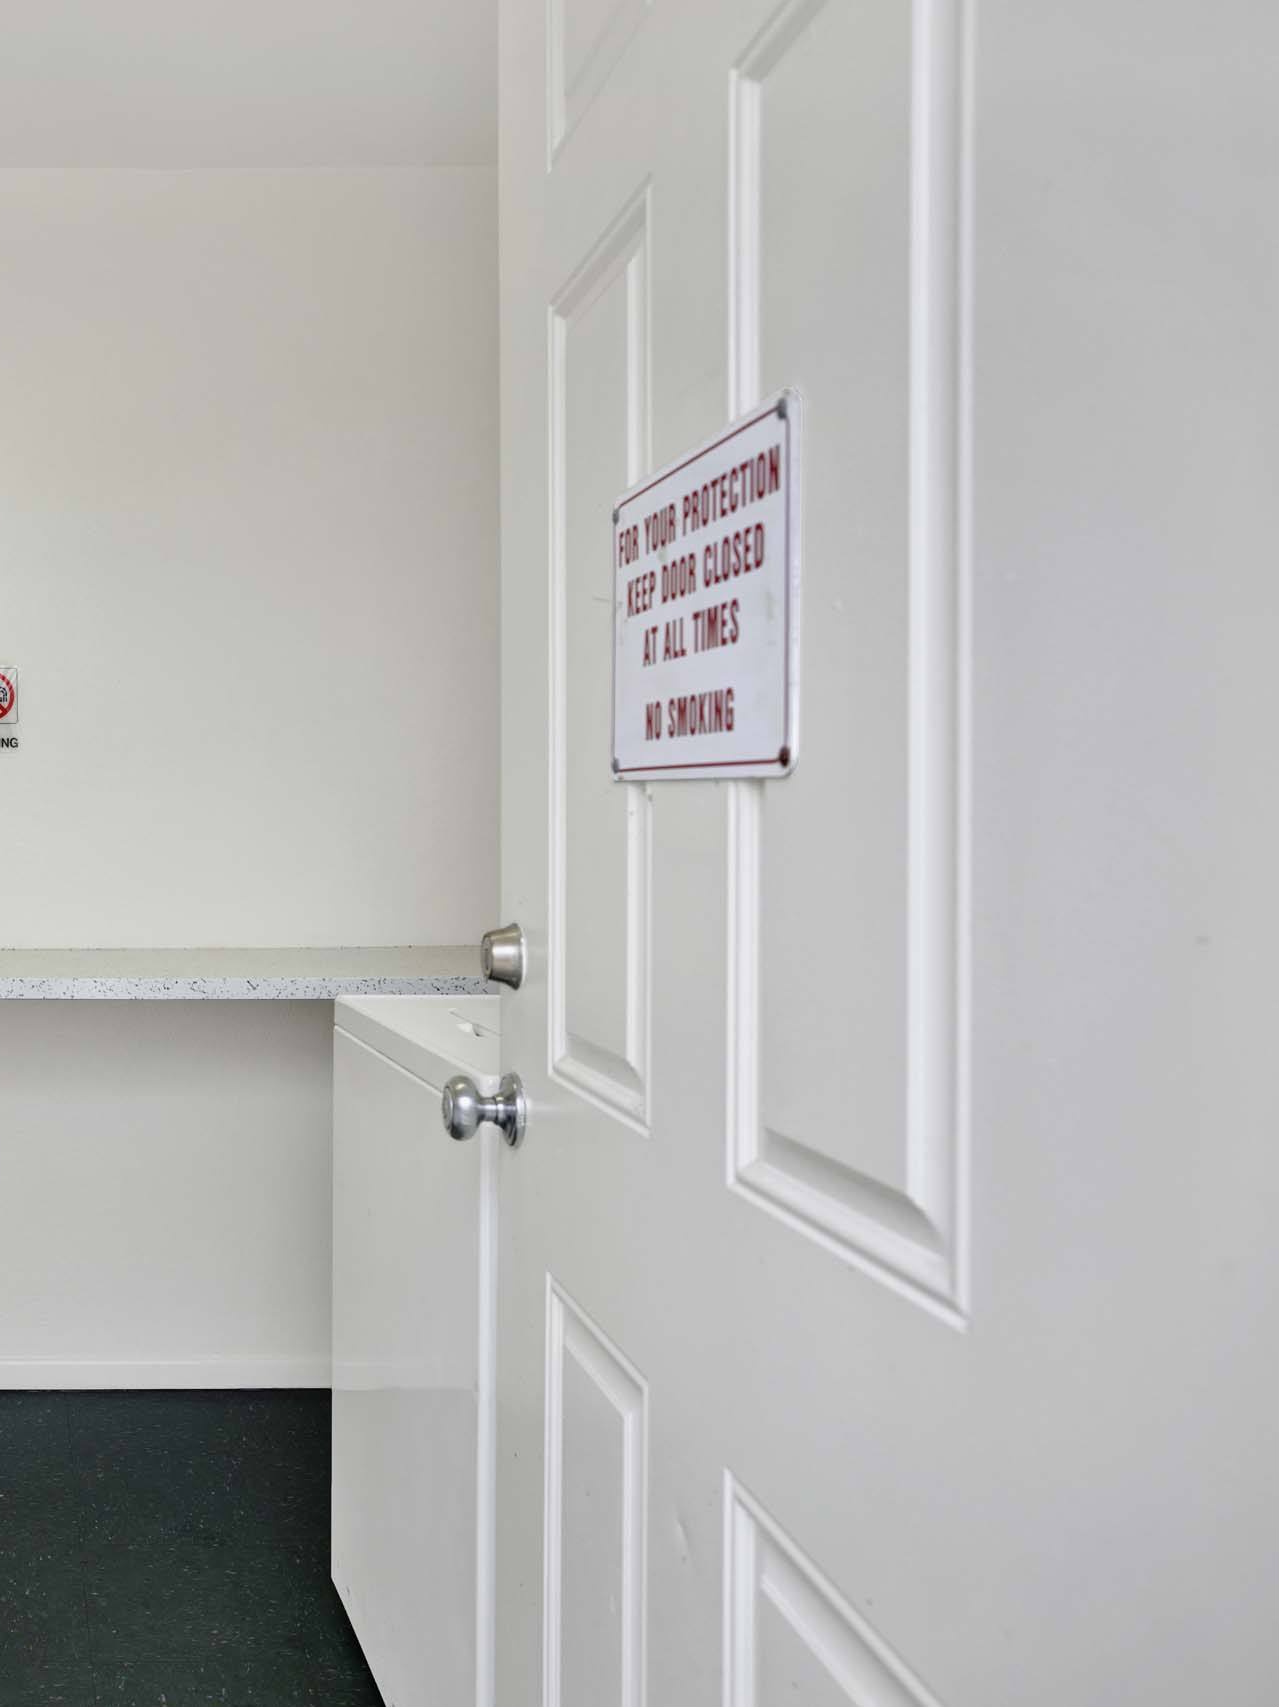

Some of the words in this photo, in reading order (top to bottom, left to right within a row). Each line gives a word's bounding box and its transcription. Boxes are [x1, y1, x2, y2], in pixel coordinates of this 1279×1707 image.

[618, 524, 639, 568] FOR
[644, 503, 676, 555] YOUR
[682, 444, 781, 536] PROTECTION
[627, 570, 657, 617] KEEP
[662, 552, 696, 604] DOOR
[704, 522, 765, 588] CLOSED
[643, 625, 658, 667] AT
[663, 617, 687, 662] ALL
[692, 598, 740, 653] TIMES
[645, 701, 662, 741] NO
[668, 687, 735, 738] SMOKING
